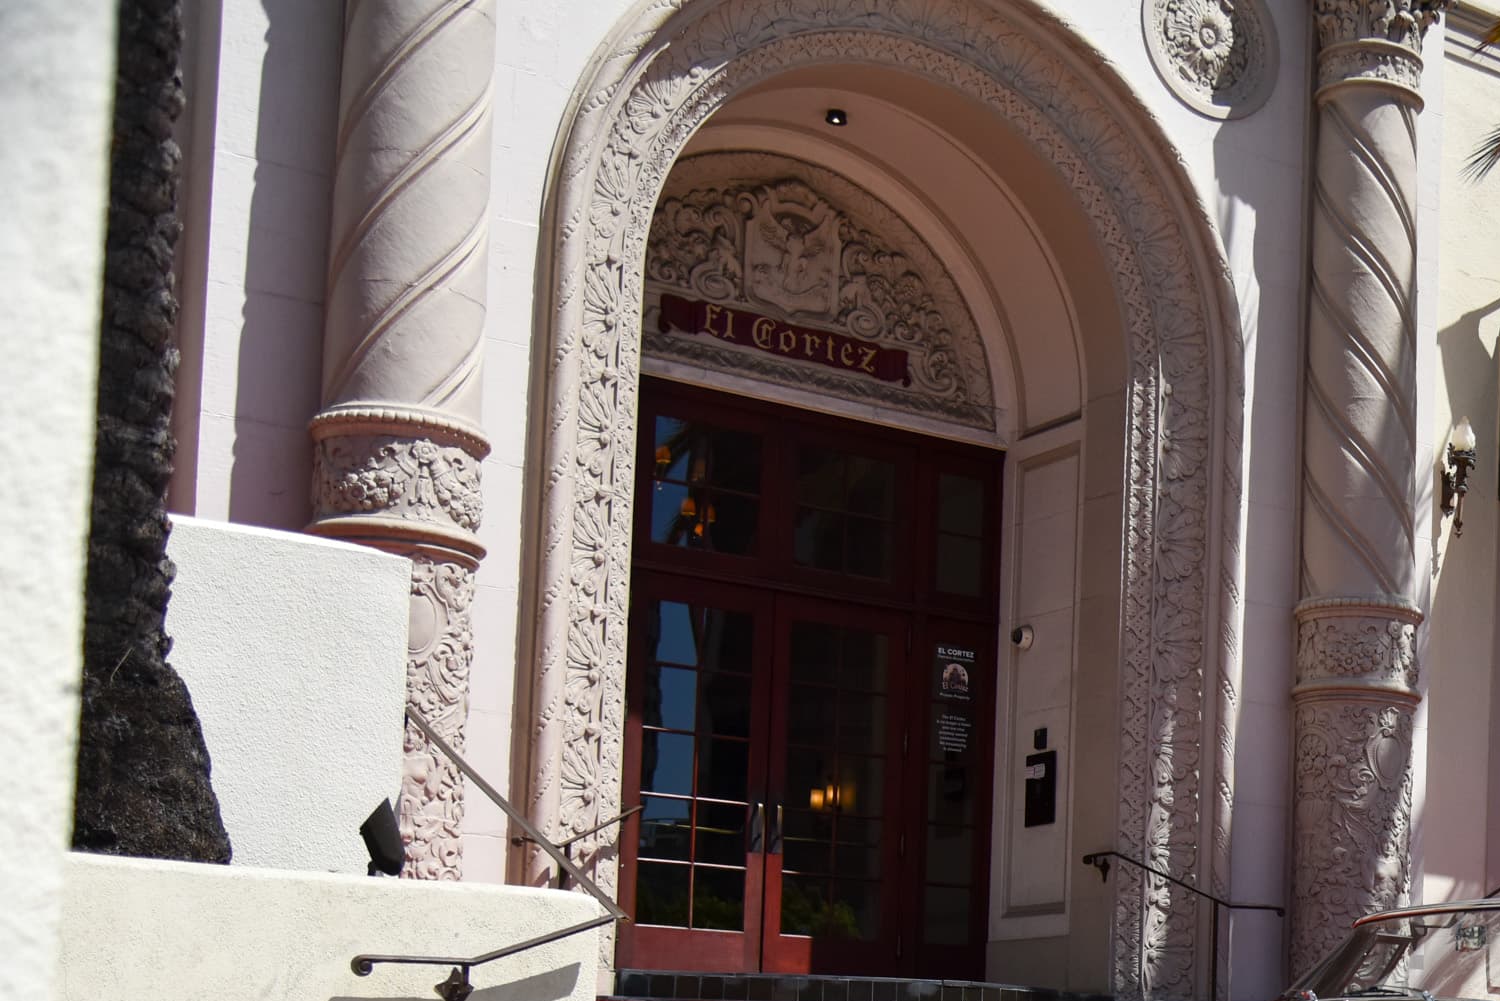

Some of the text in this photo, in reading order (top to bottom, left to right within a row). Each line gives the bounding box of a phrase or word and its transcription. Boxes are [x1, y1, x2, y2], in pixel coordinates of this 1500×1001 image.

[704, 303, 877, 373] El Cortez
[938, 647, 946, 655] EL
[947, 648, 975, 659] CORTEZ
